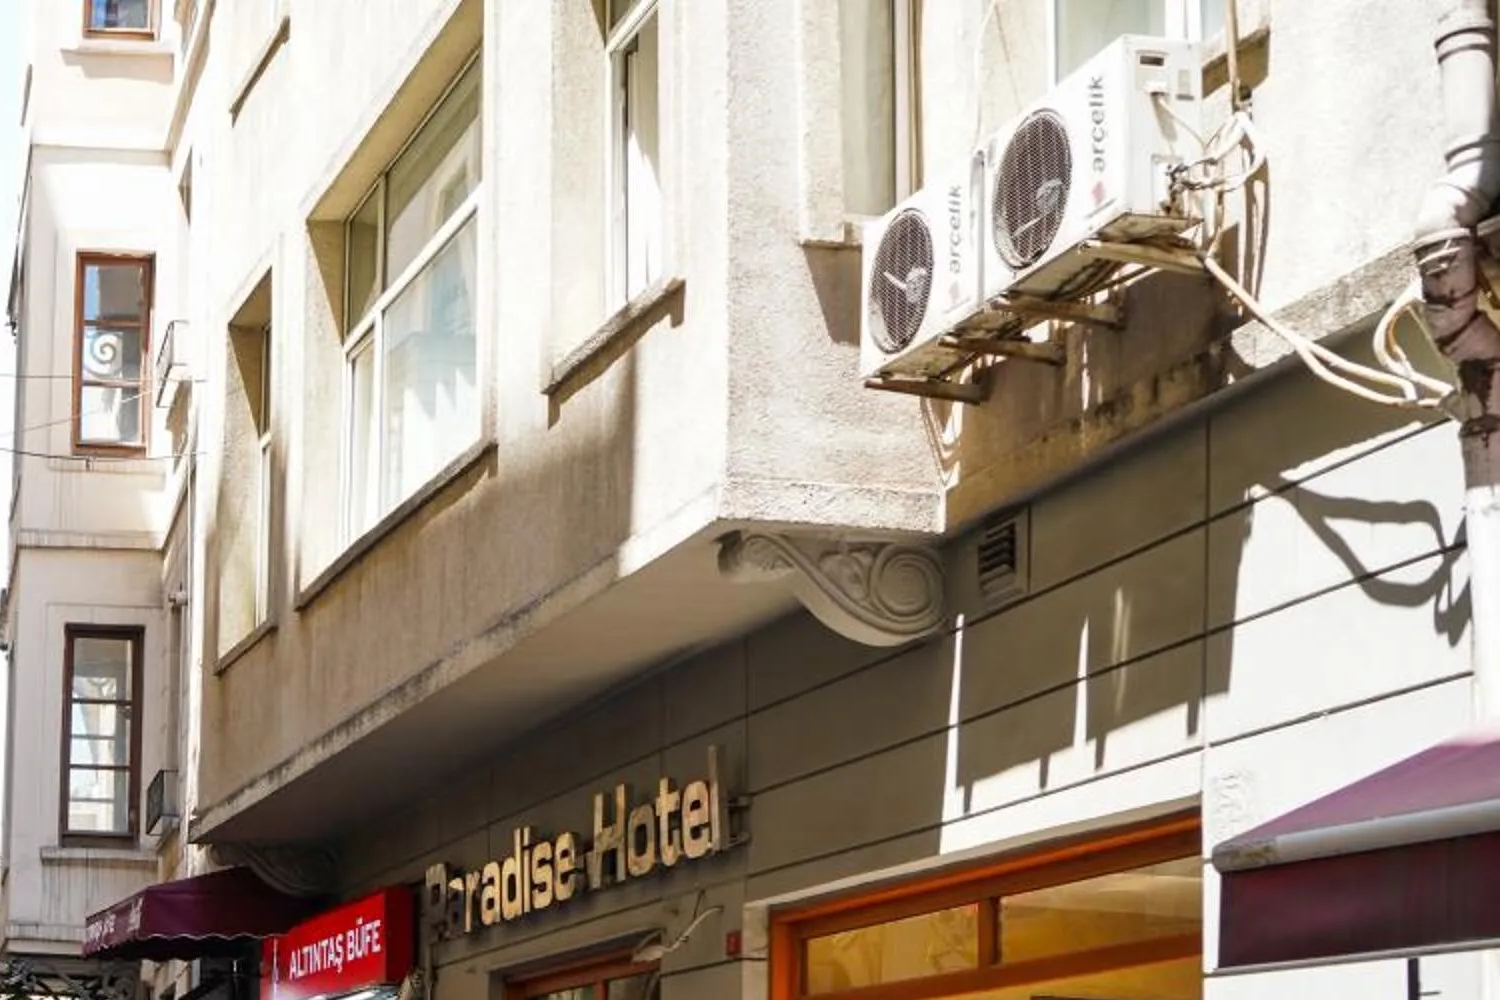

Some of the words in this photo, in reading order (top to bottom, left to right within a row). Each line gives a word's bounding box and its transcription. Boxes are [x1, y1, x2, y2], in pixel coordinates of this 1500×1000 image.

[422, 825, 578, 938] Paradise
[587, 744, 723, 892] Hotel
[288, 933, 345, 980] ALTINTAŞ
[346, 916, 382, 962] BÜFE
